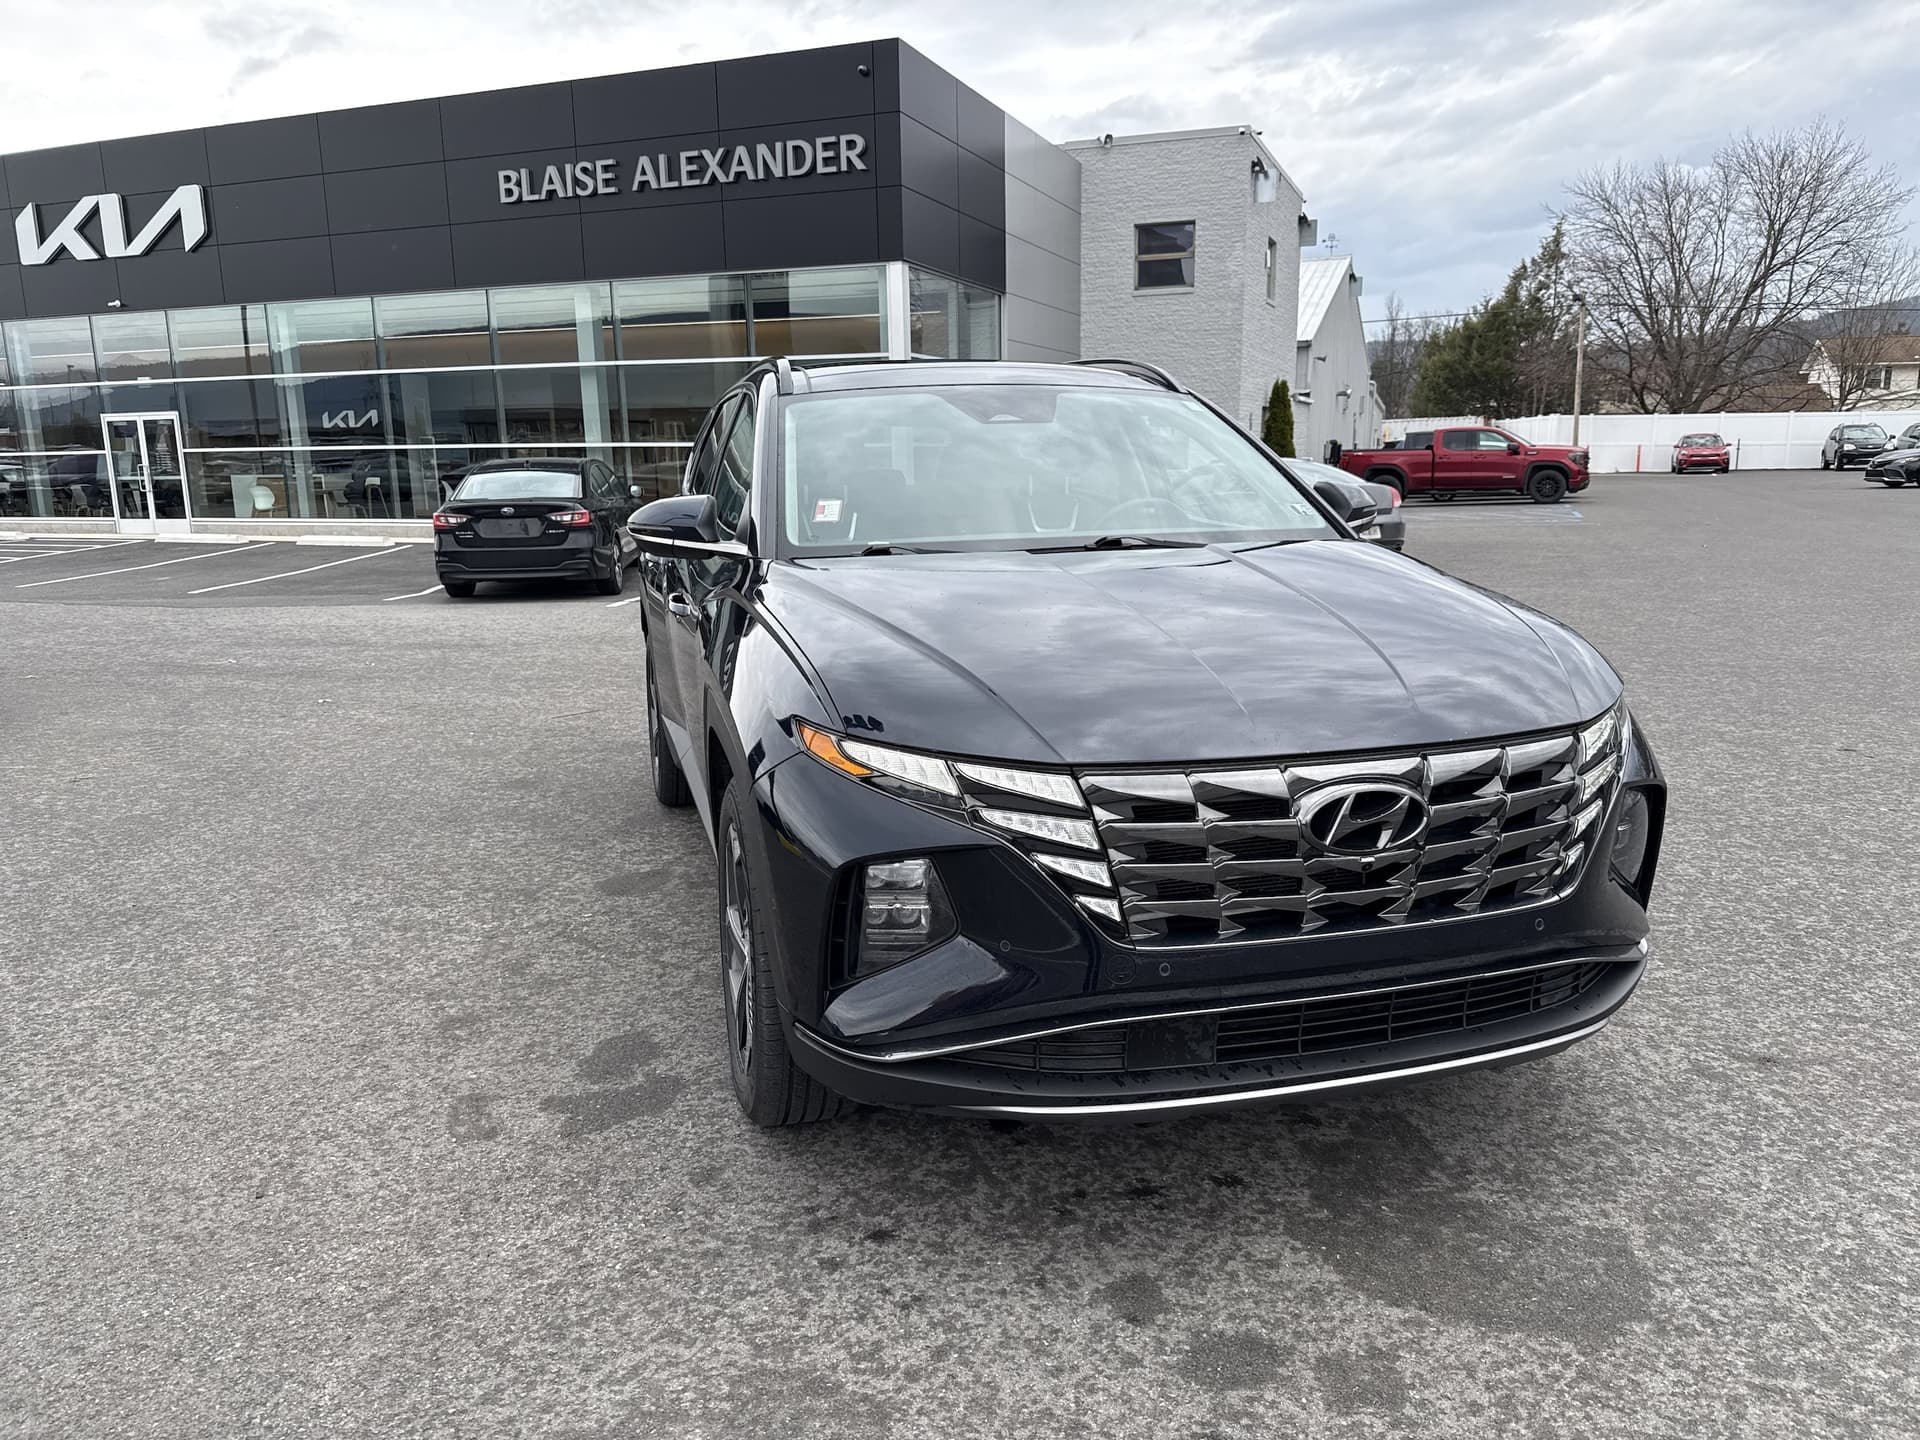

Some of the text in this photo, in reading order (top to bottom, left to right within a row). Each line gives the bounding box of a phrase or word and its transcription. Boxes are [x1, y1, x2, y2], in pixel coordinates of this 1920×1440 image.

[498, 133, 868, 204] BLAISE ALEXANDER
[15, 184, 208, 266] KIA
[321, 409, 379, 429] KIA
